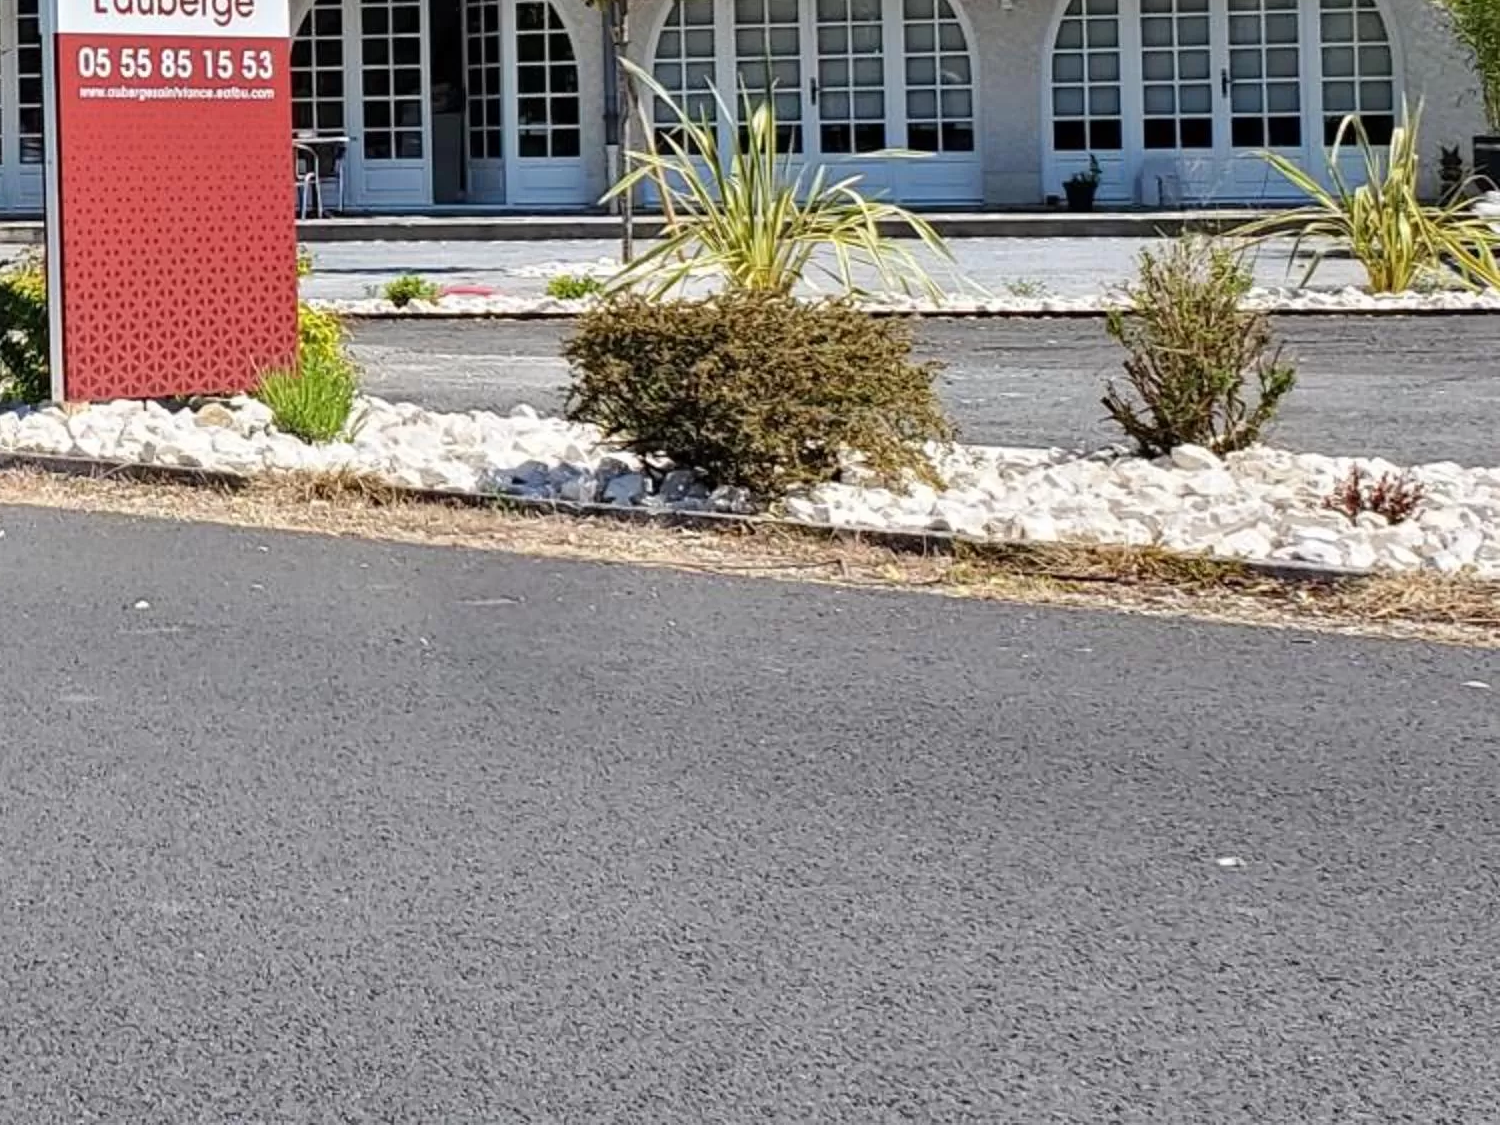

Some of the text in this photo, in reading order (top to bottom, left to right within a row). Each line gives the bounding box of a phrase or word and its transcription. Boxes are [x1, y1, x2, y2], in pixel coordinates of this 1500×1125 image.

[78, 46, 273, 80] 05 55 85 15 53
